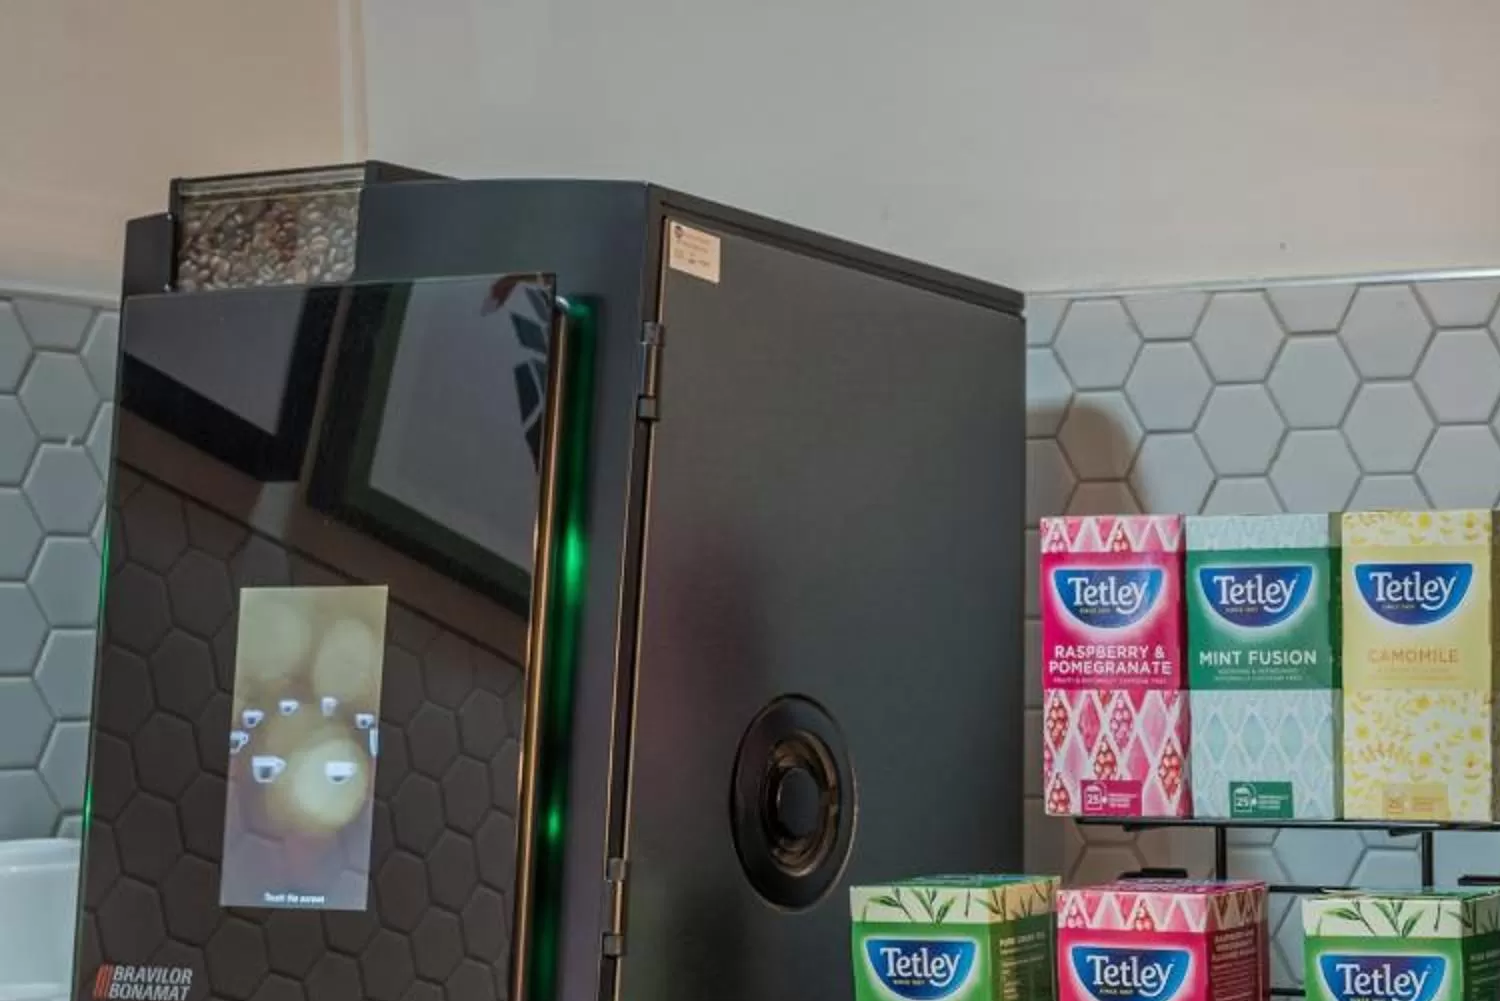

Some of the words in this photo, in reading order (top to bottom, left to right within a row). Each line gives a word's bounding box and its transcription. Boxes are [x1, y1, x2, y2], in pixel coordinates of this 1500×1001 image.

[1067, 576, 1148, 614] Tetley
[1213, 574, 1297, 613] Tetley
[1368, 571, 1457, 611] Tetley
[1055, 645, 1149, 659] RASPBERRY
[1154, 645, 1165, 659] &
[1199, 650, 1242, 666] MINT
[1248, 649, 1317, 665] FUSION
[1368, 647, 1459, 664] CAMOMILE
[1048, 661, 1172, 676] POMEGRANATE
[112, 965, 193, 985] BRAVILOR
[880, 947, 962, 988] Tetley
[1086, 955, 1174, 997] Tetley
[109, 983, 190, 1001] BONAMAT
